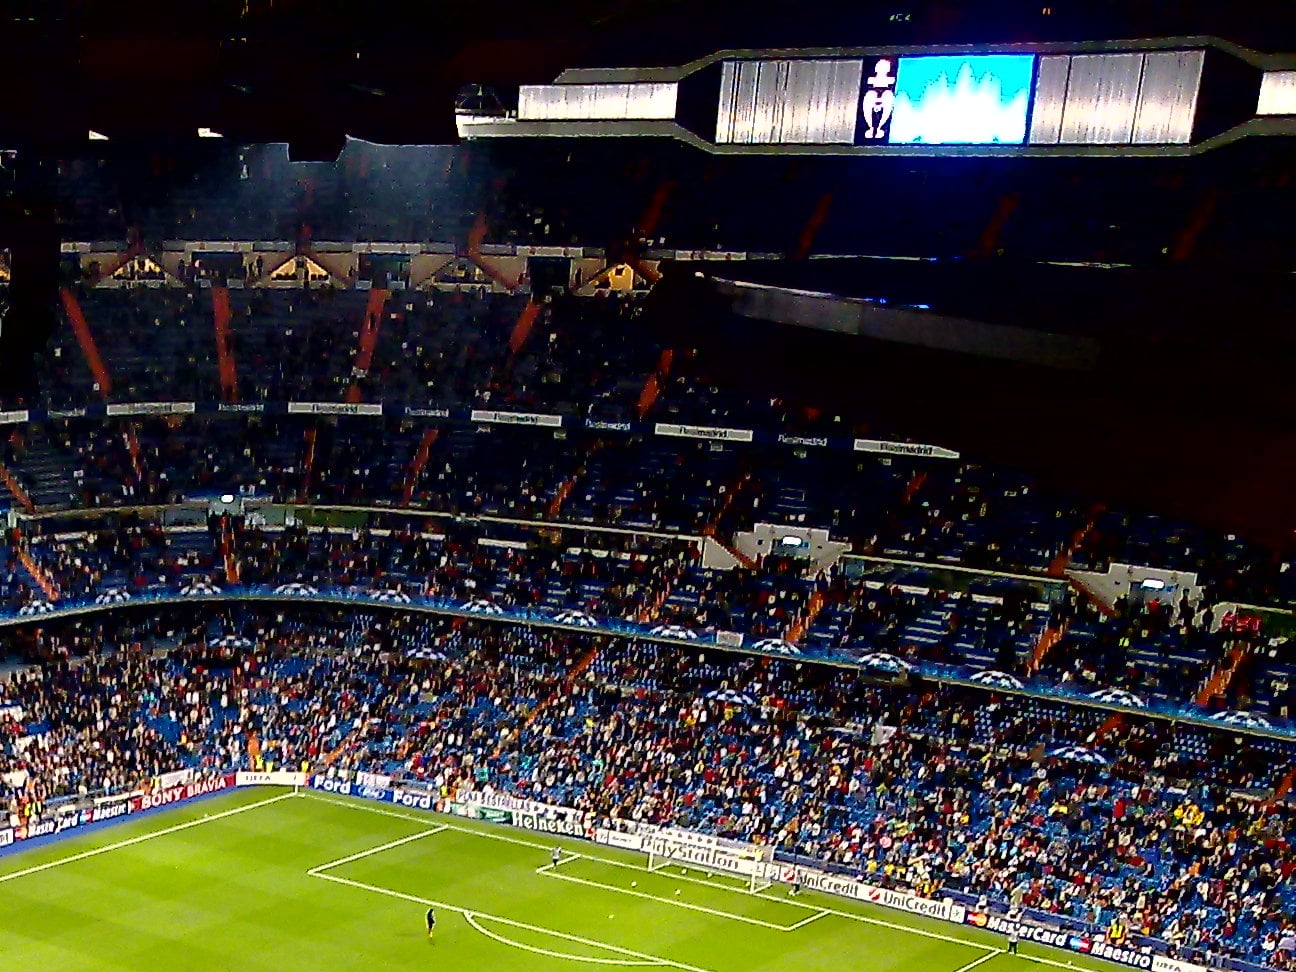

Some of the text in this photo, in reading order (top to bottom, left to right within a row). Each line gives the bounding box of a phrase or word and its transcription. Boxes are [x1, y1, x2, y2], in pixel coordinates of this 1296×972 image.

[314, 774, 351, 795] Ford
[392, 789, 431, 809] Ford
[512, 811, 584, 837] Heineken
[801, 868, 859, 897] UniCredit
[883, 892, 947, 917] UniCredit
[1090, 942, 1151, 968] Maestro
